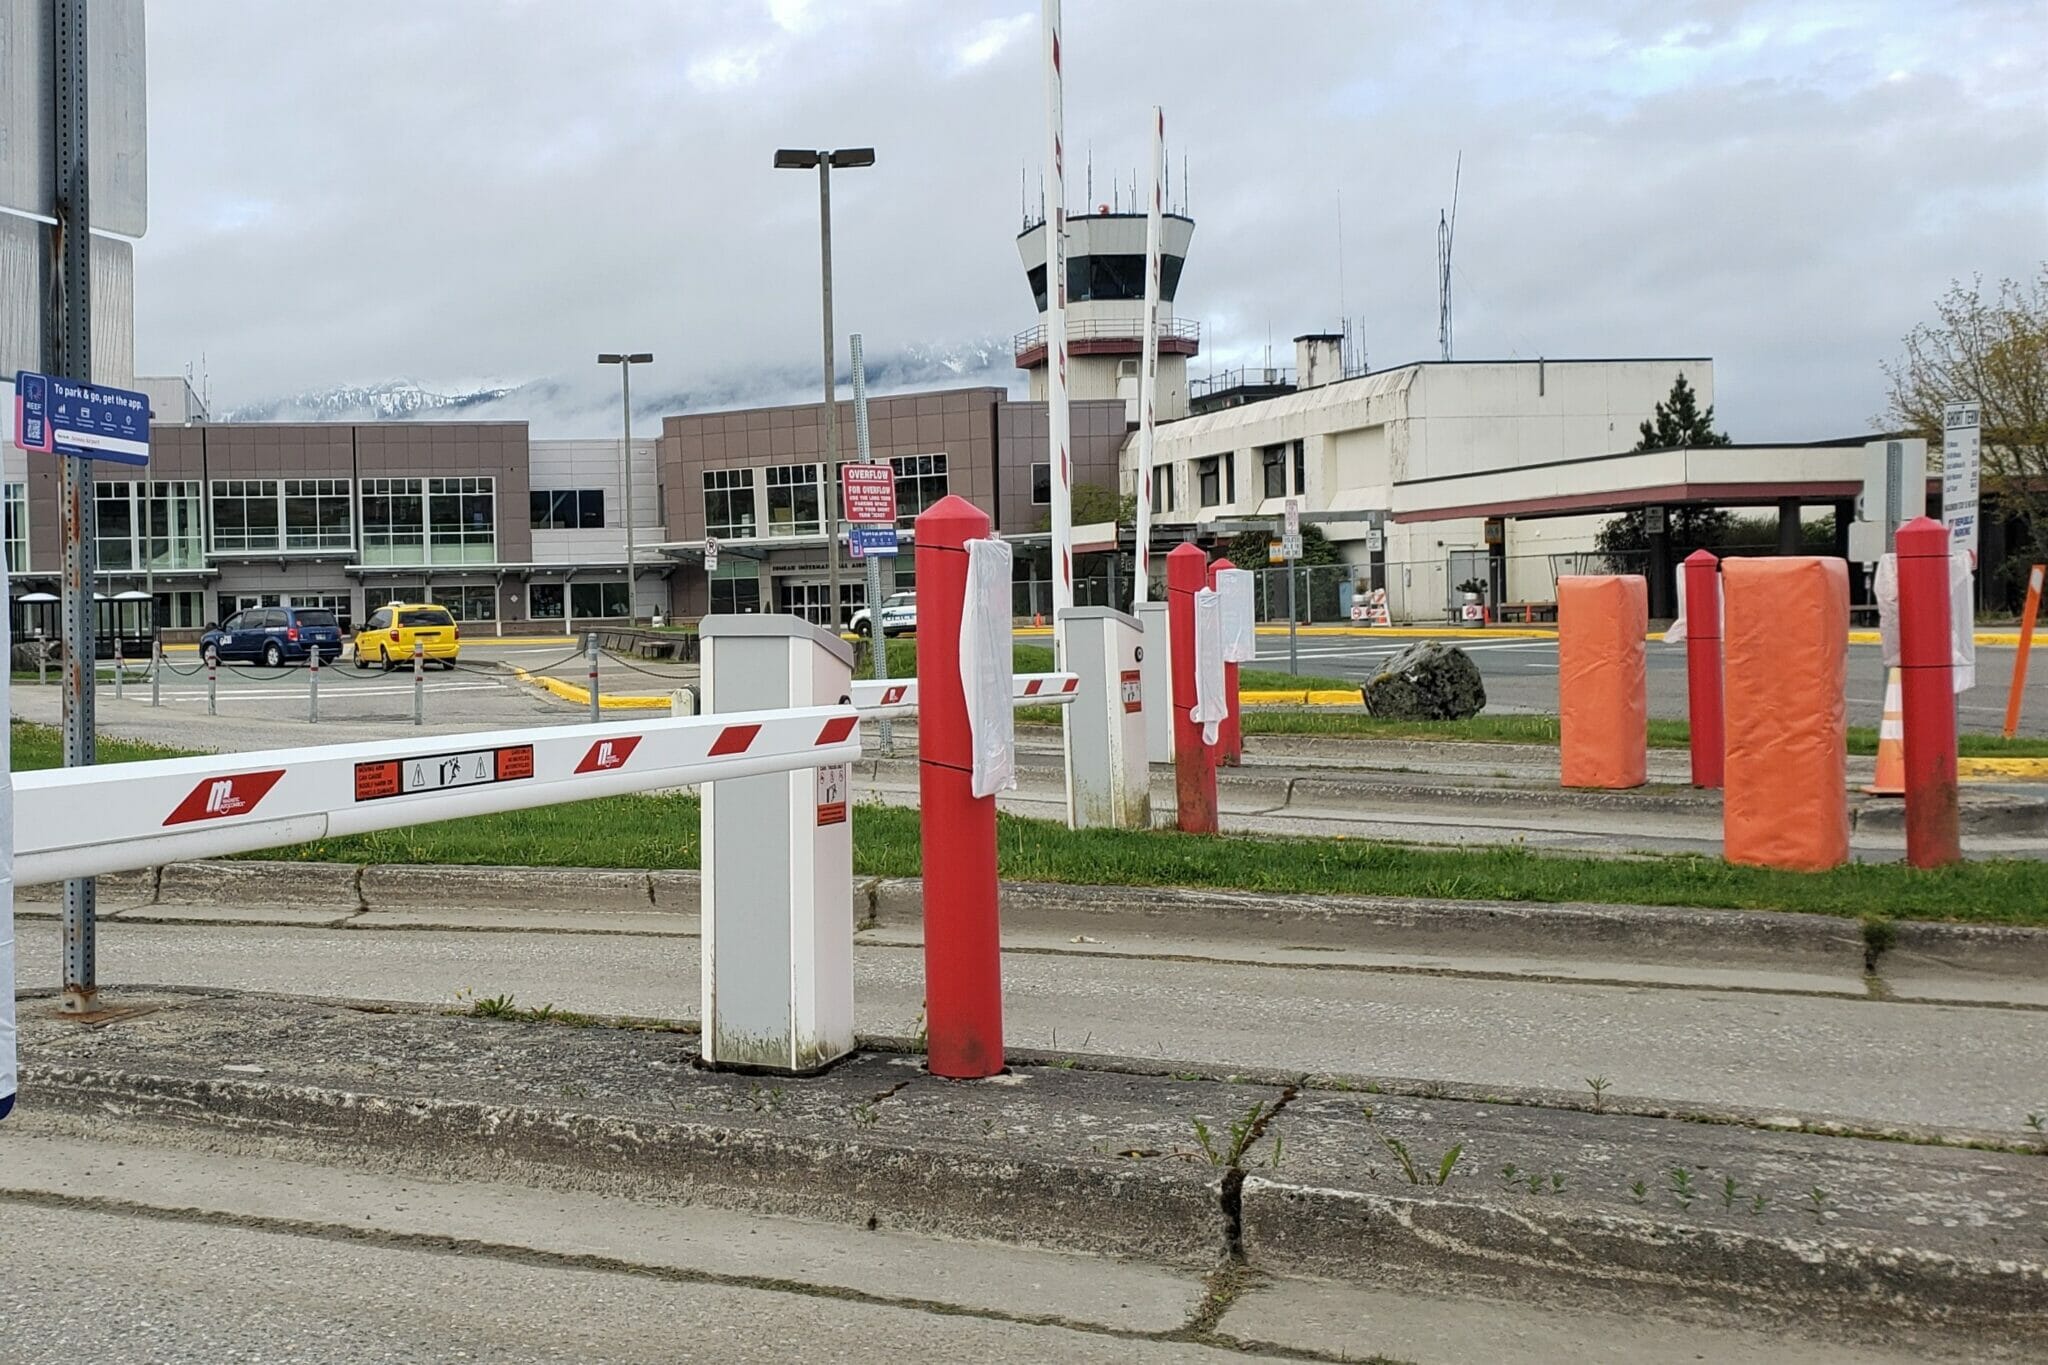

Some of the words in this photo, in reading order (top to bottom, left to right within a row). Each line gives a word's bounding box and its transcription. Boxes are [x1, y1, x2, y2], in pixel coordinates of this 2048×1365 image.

[54, 383, 63, 395] To
[65, 387, 82, 398] park
[83, 389, 89, 399] &
[91, 392, 101, 403] go,
[103, 394, 115, 405] get
[116, 395, 127, 406] the
[128, 399, 143, 411] app.
[26, 401, 42, 410] REEF
[849, 469, 888, 480] OVERFLOW
[848, 485, 861, 494] FOR
[862, 486, 890, 495] OVERFLOW
[799, 562, 848, 571] INTERNATAL
